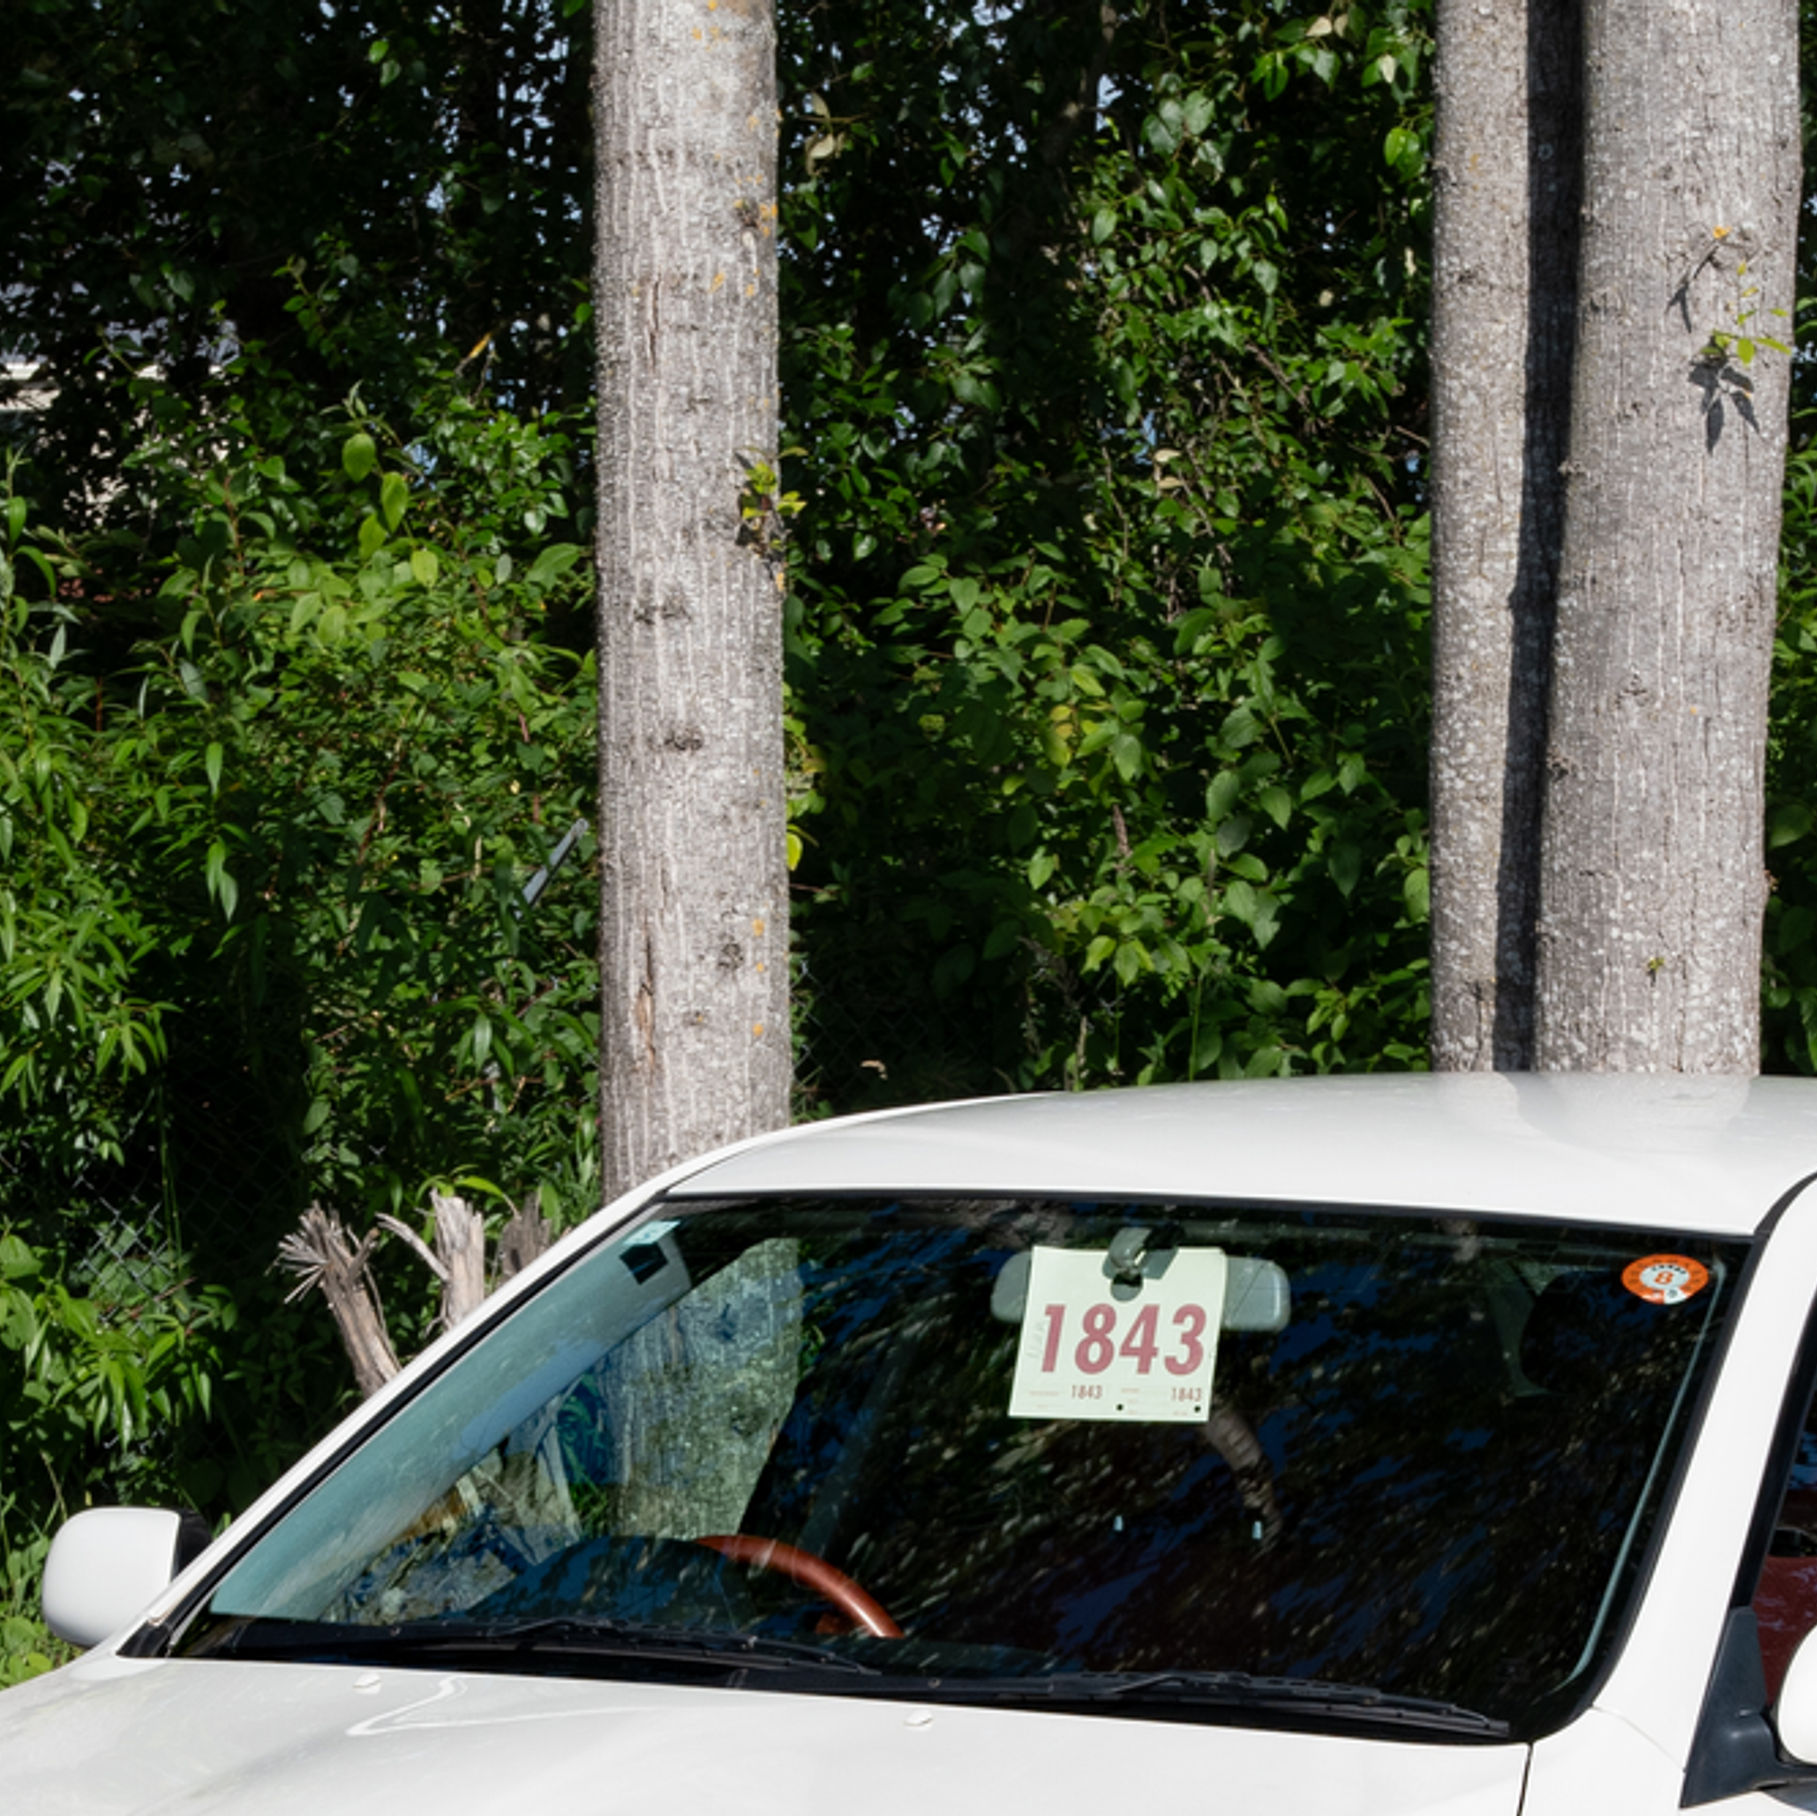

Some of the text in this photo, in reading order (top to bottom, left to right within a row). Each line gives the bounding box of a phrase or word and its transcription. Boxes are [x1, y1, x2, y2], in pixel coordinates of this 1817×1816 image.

[1041, 1303, 1207, 1375] 1843
[1071, 1385, 1103, 1400] 1843
[1171, 1387, 1202, 1403] 1843
